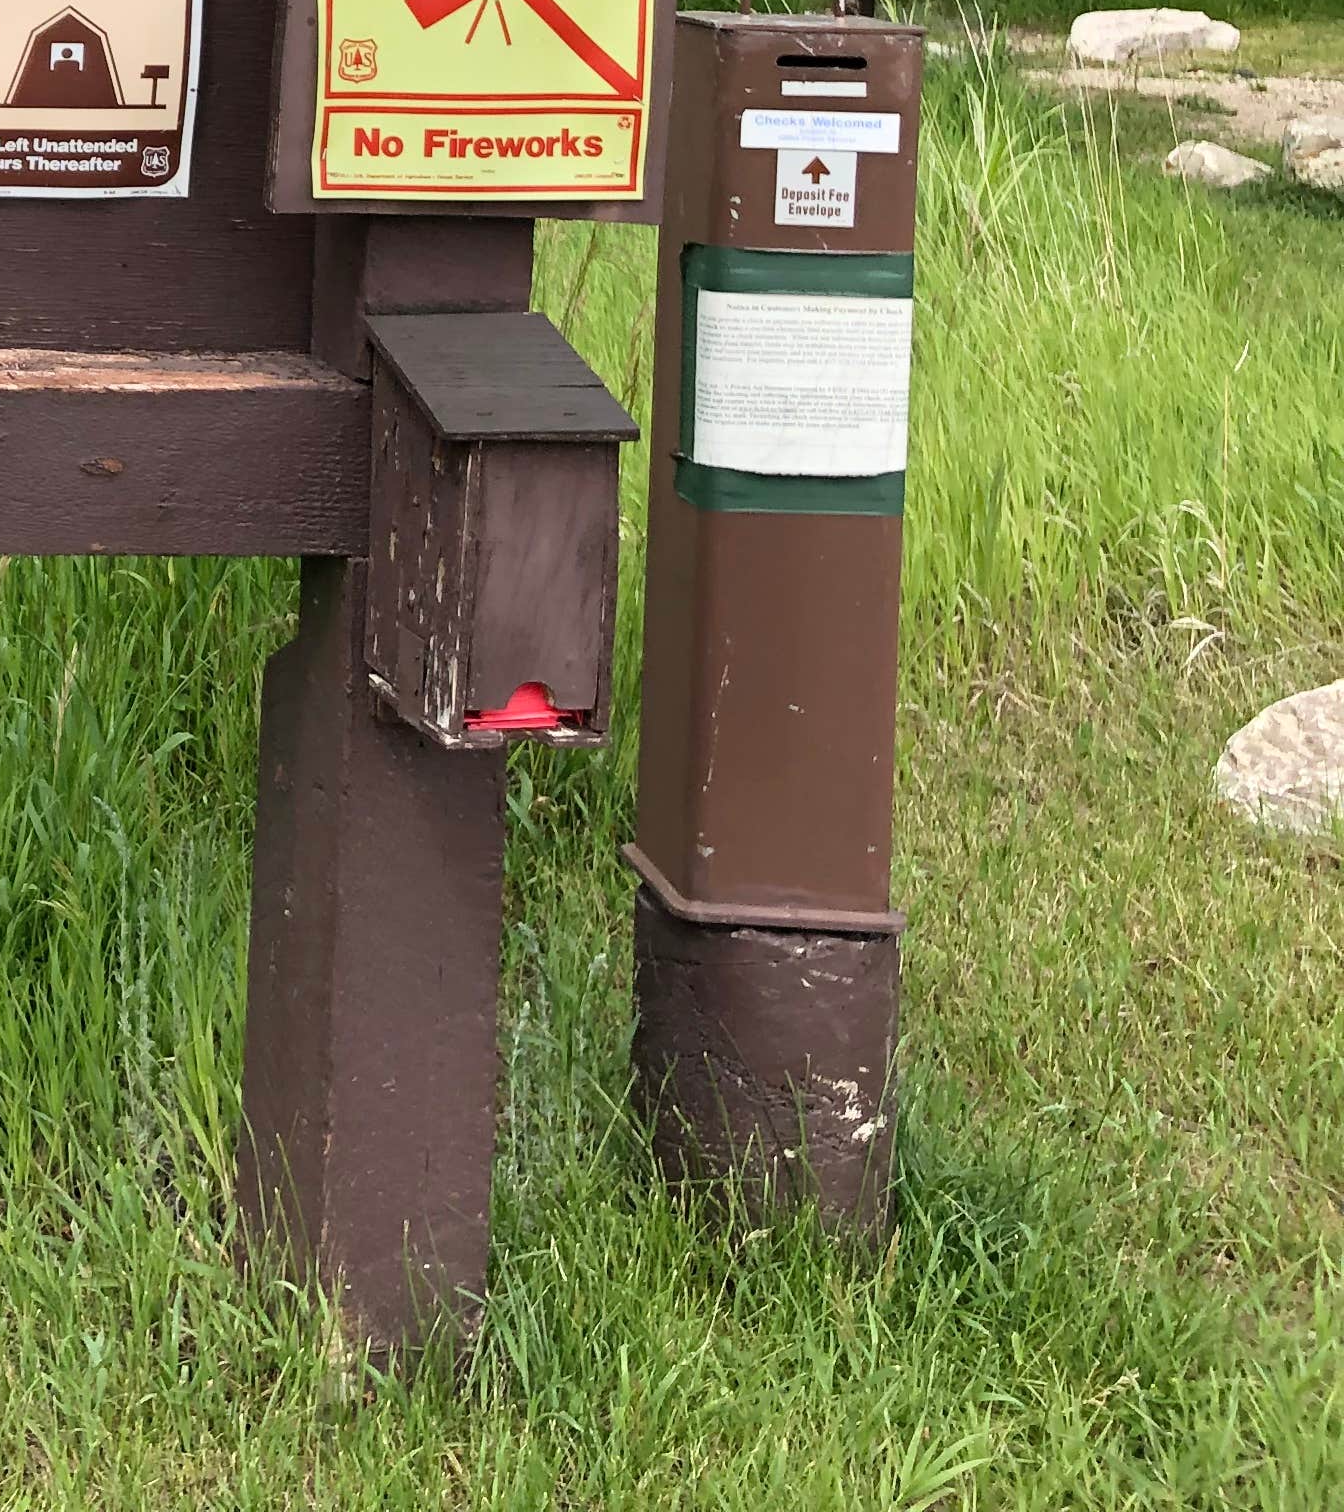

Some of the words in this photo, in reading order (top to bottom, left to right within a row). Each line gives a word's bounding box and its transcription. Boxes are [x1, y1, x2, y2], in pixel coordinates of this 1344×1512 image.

[754, 115, 806, 127] Checks
[811, 116, 882, 129] Welcomed
[32, 137, 138, 153] Unattended
[354, 128, 403, 157] No
[424, 129, 602, 158] Fireworks
[25, 155, 122, 172] Thereafter
[781, 187, 826, 203] Deposit
[828, 188, 850, 203] Fee
[788, 202, 841, 219] Envelope
